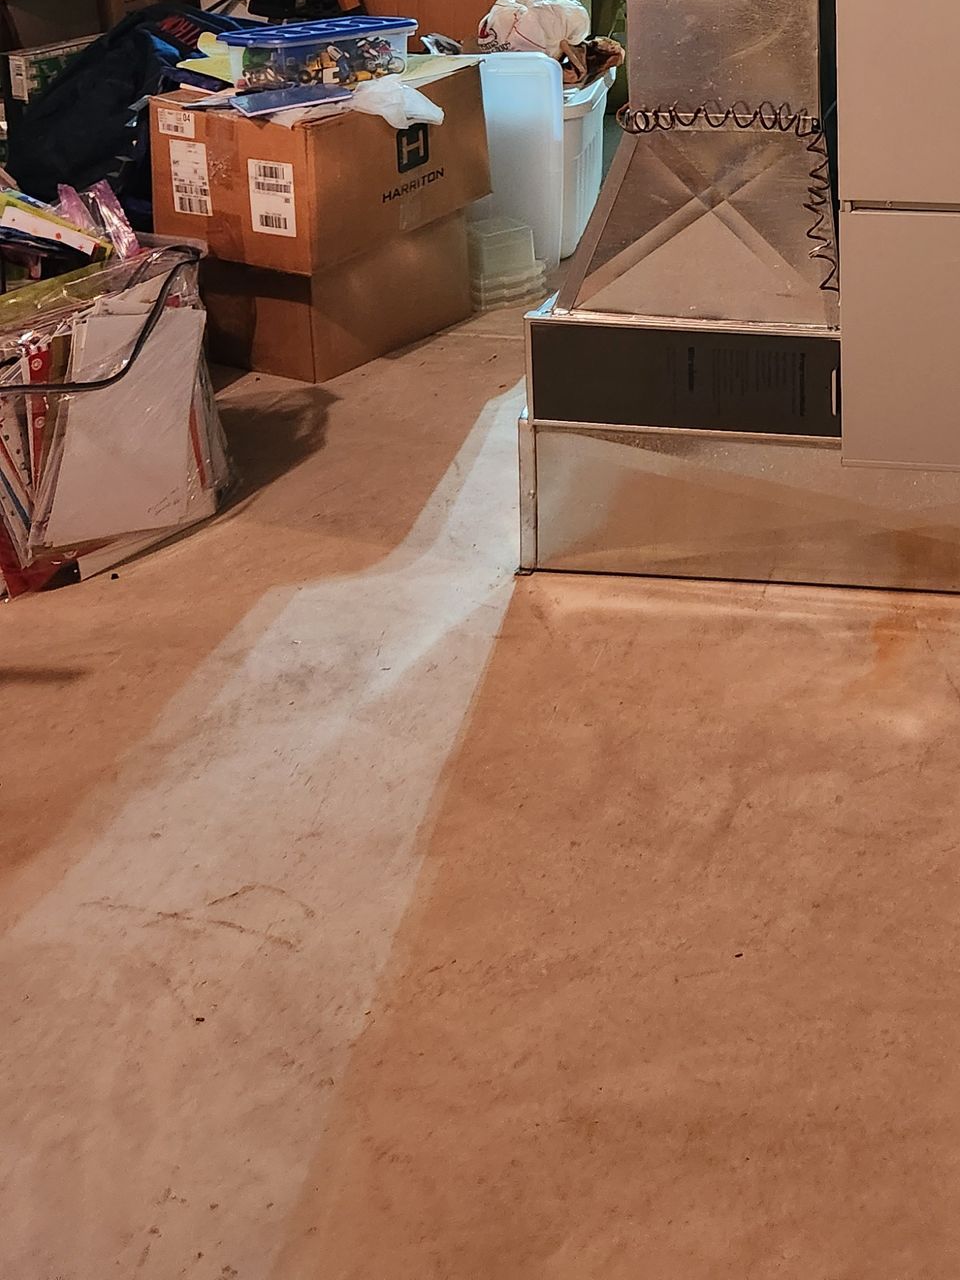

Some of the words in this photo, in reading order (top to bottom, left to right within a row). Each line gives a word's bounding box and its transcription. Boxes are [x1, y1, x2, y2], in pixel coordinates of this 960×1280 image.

[182, 113, 191, 123] 04
[402, 129, 424, 164] H
[382, 167, 444, 204] HARRITON
